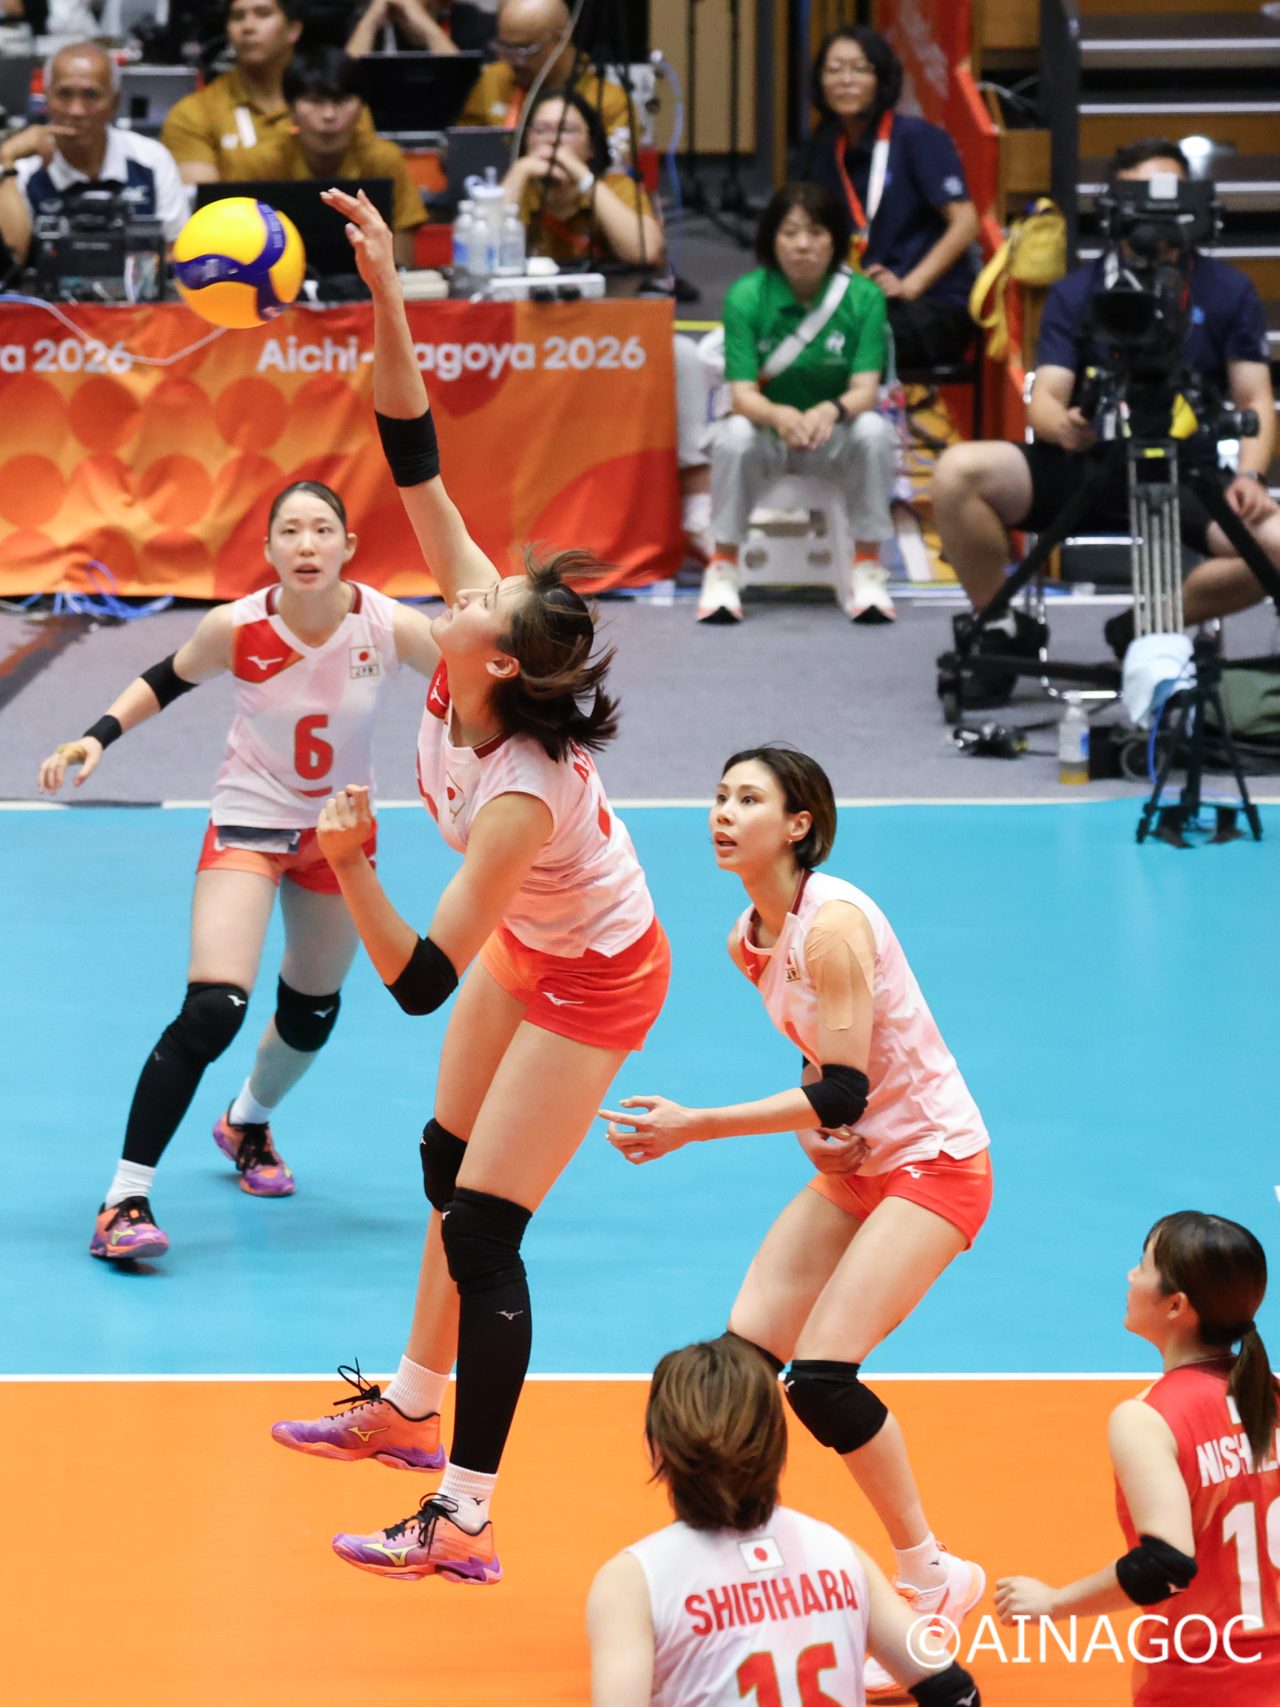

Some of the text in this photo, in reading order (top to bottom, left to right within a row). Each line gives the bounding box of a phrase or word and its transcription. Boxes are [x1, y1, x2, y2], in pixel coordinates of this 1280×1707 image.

[32, 339, 132, 375] 2026
[256, 335, 647, 382] Aichi-agoya 2026
[294, 713, 334, 781] 6
[684, 1569, 859, 1637] SHIGIHARA
